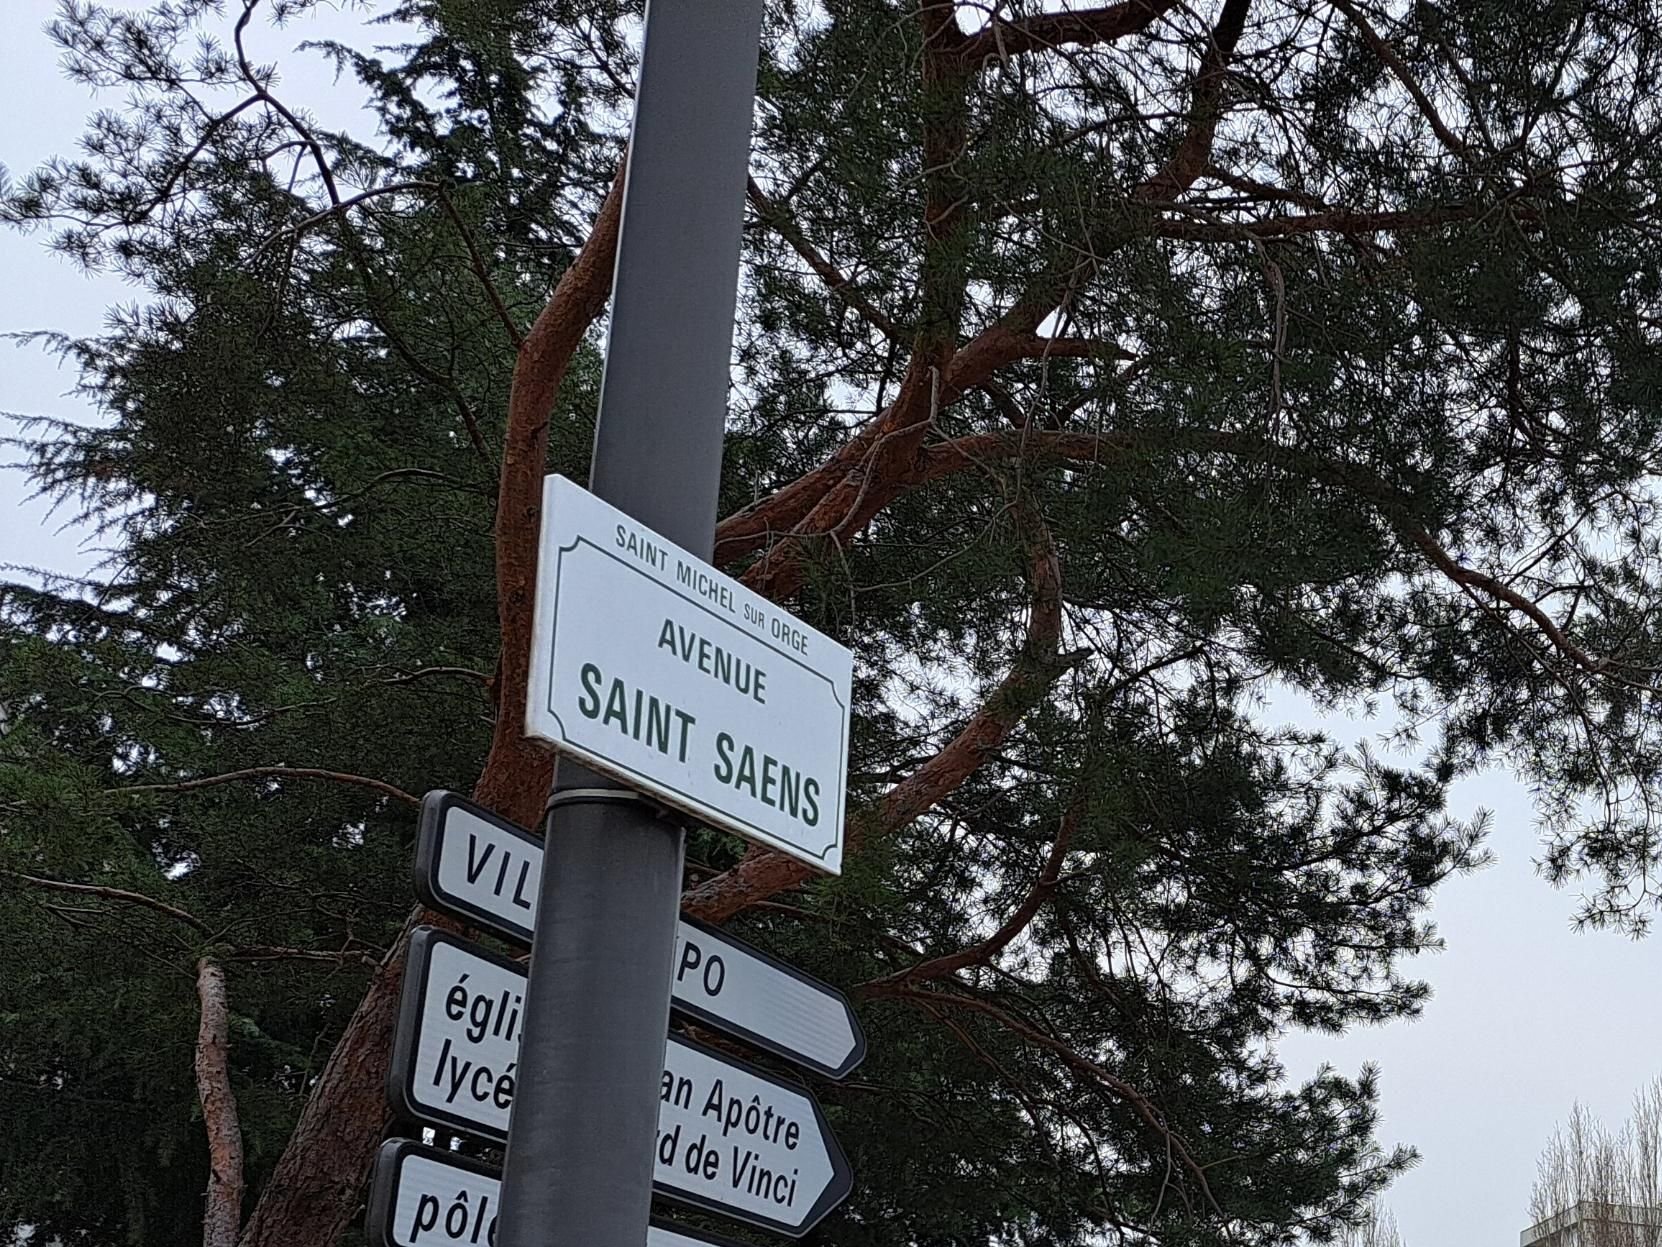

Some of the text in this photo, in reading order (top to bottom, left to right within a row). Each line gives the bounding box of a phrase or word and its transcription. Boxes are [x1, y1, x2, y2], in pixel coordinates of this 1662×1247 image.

[616, 524, 809, 656] SAINT MICHEL SUR ORGE
[657, 619, 767, 704] AVENUE
[578, 662, 821, 827] SAINT SAENS
[445, 974, 523, 1044] égli
[702, 1078, 800, 1151] Apôtre
[656, 1125, 799, 1207] d de Vinci
